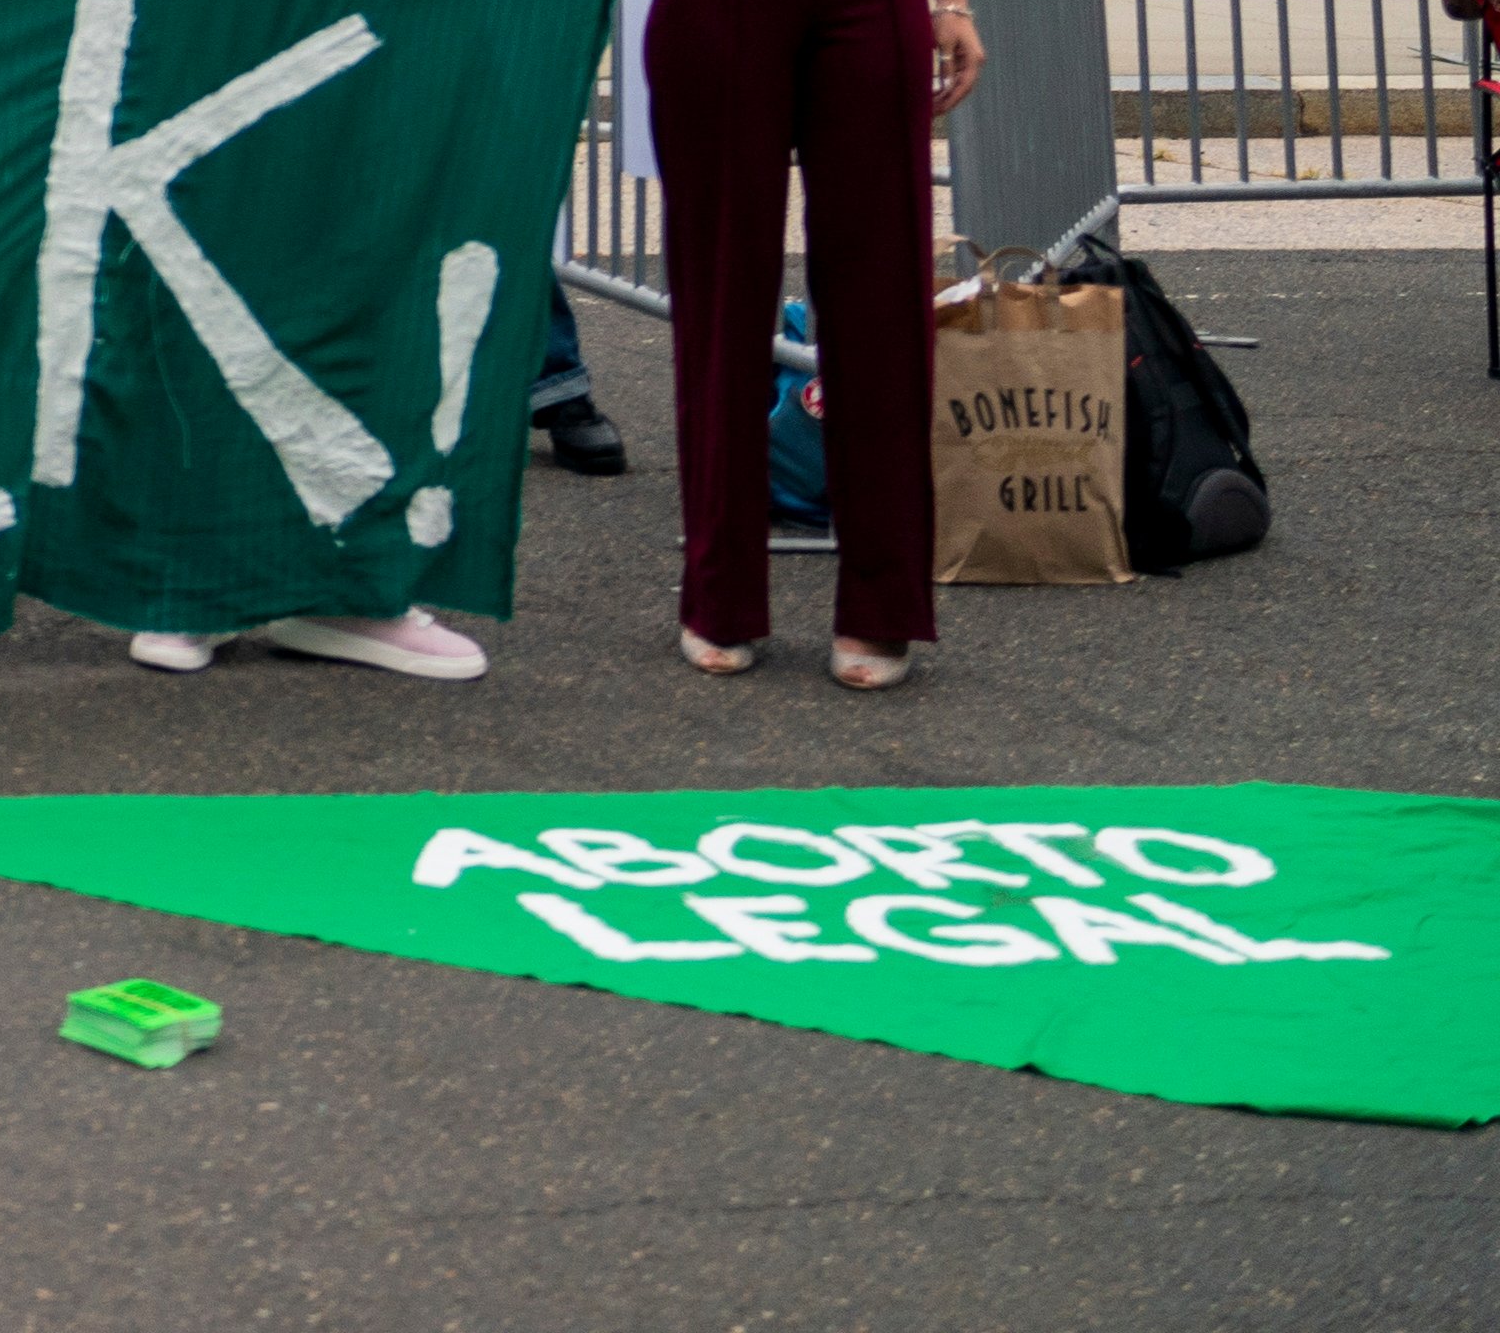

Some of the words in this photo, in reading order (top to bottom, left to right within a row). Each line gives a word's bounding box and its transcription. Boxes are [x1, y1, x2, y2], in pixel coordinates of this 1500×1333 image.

[949, 386, 1111, 441] BONEFISH
[1000, 475, 1090, 513] GRILL
[411, 819, 1277, 890] ABORTO
[516, 892, 1392, 966] LEGAL
